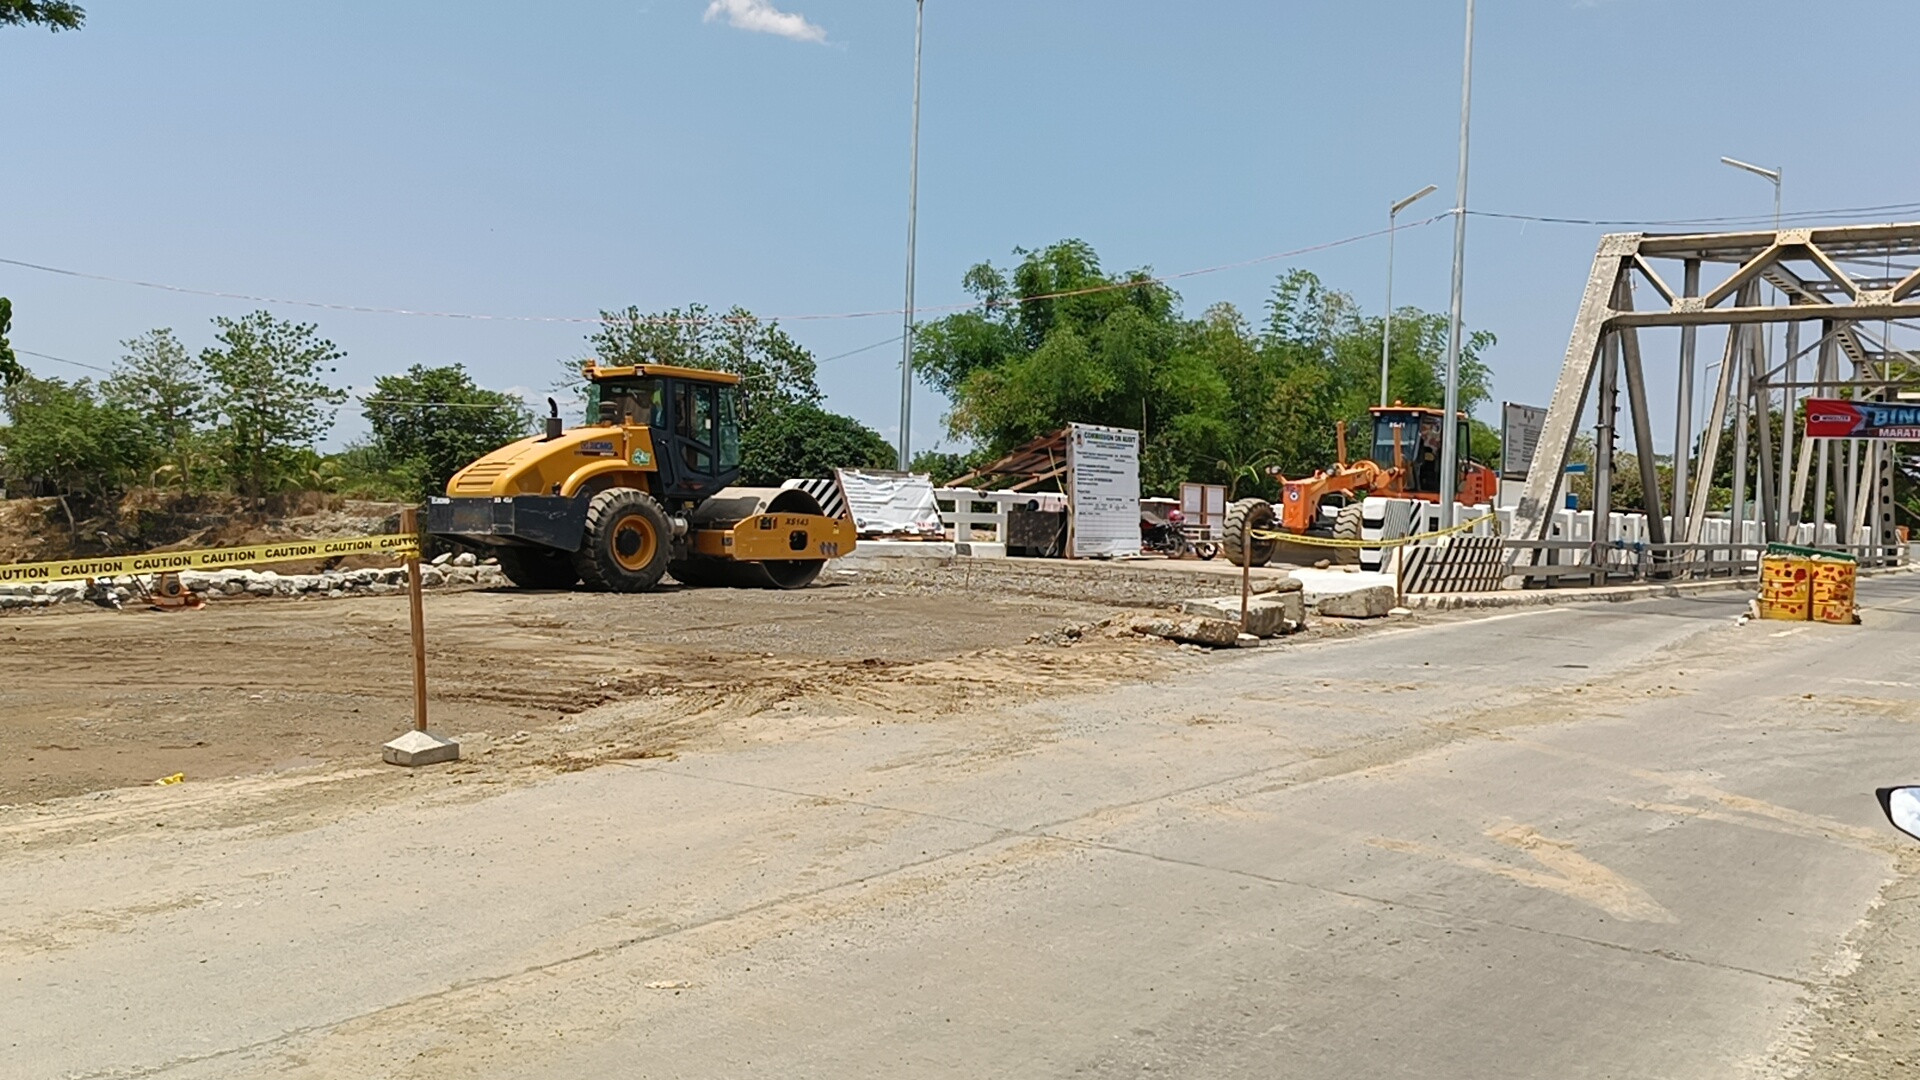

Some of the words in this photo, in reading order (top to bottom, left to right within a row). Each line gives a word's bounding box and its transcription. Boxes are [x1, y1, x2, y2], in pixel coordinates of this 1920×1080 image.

[785, 517, 809, 526] XS143
[61, 561, 123, 575] CAUTION
[133, 556, 192, 570] CAUTION
[202, 551, 256, 564] CAUTION
[265, 546, 316, 558] CAUTION
[324, 541, 372, 553] CAUTION
